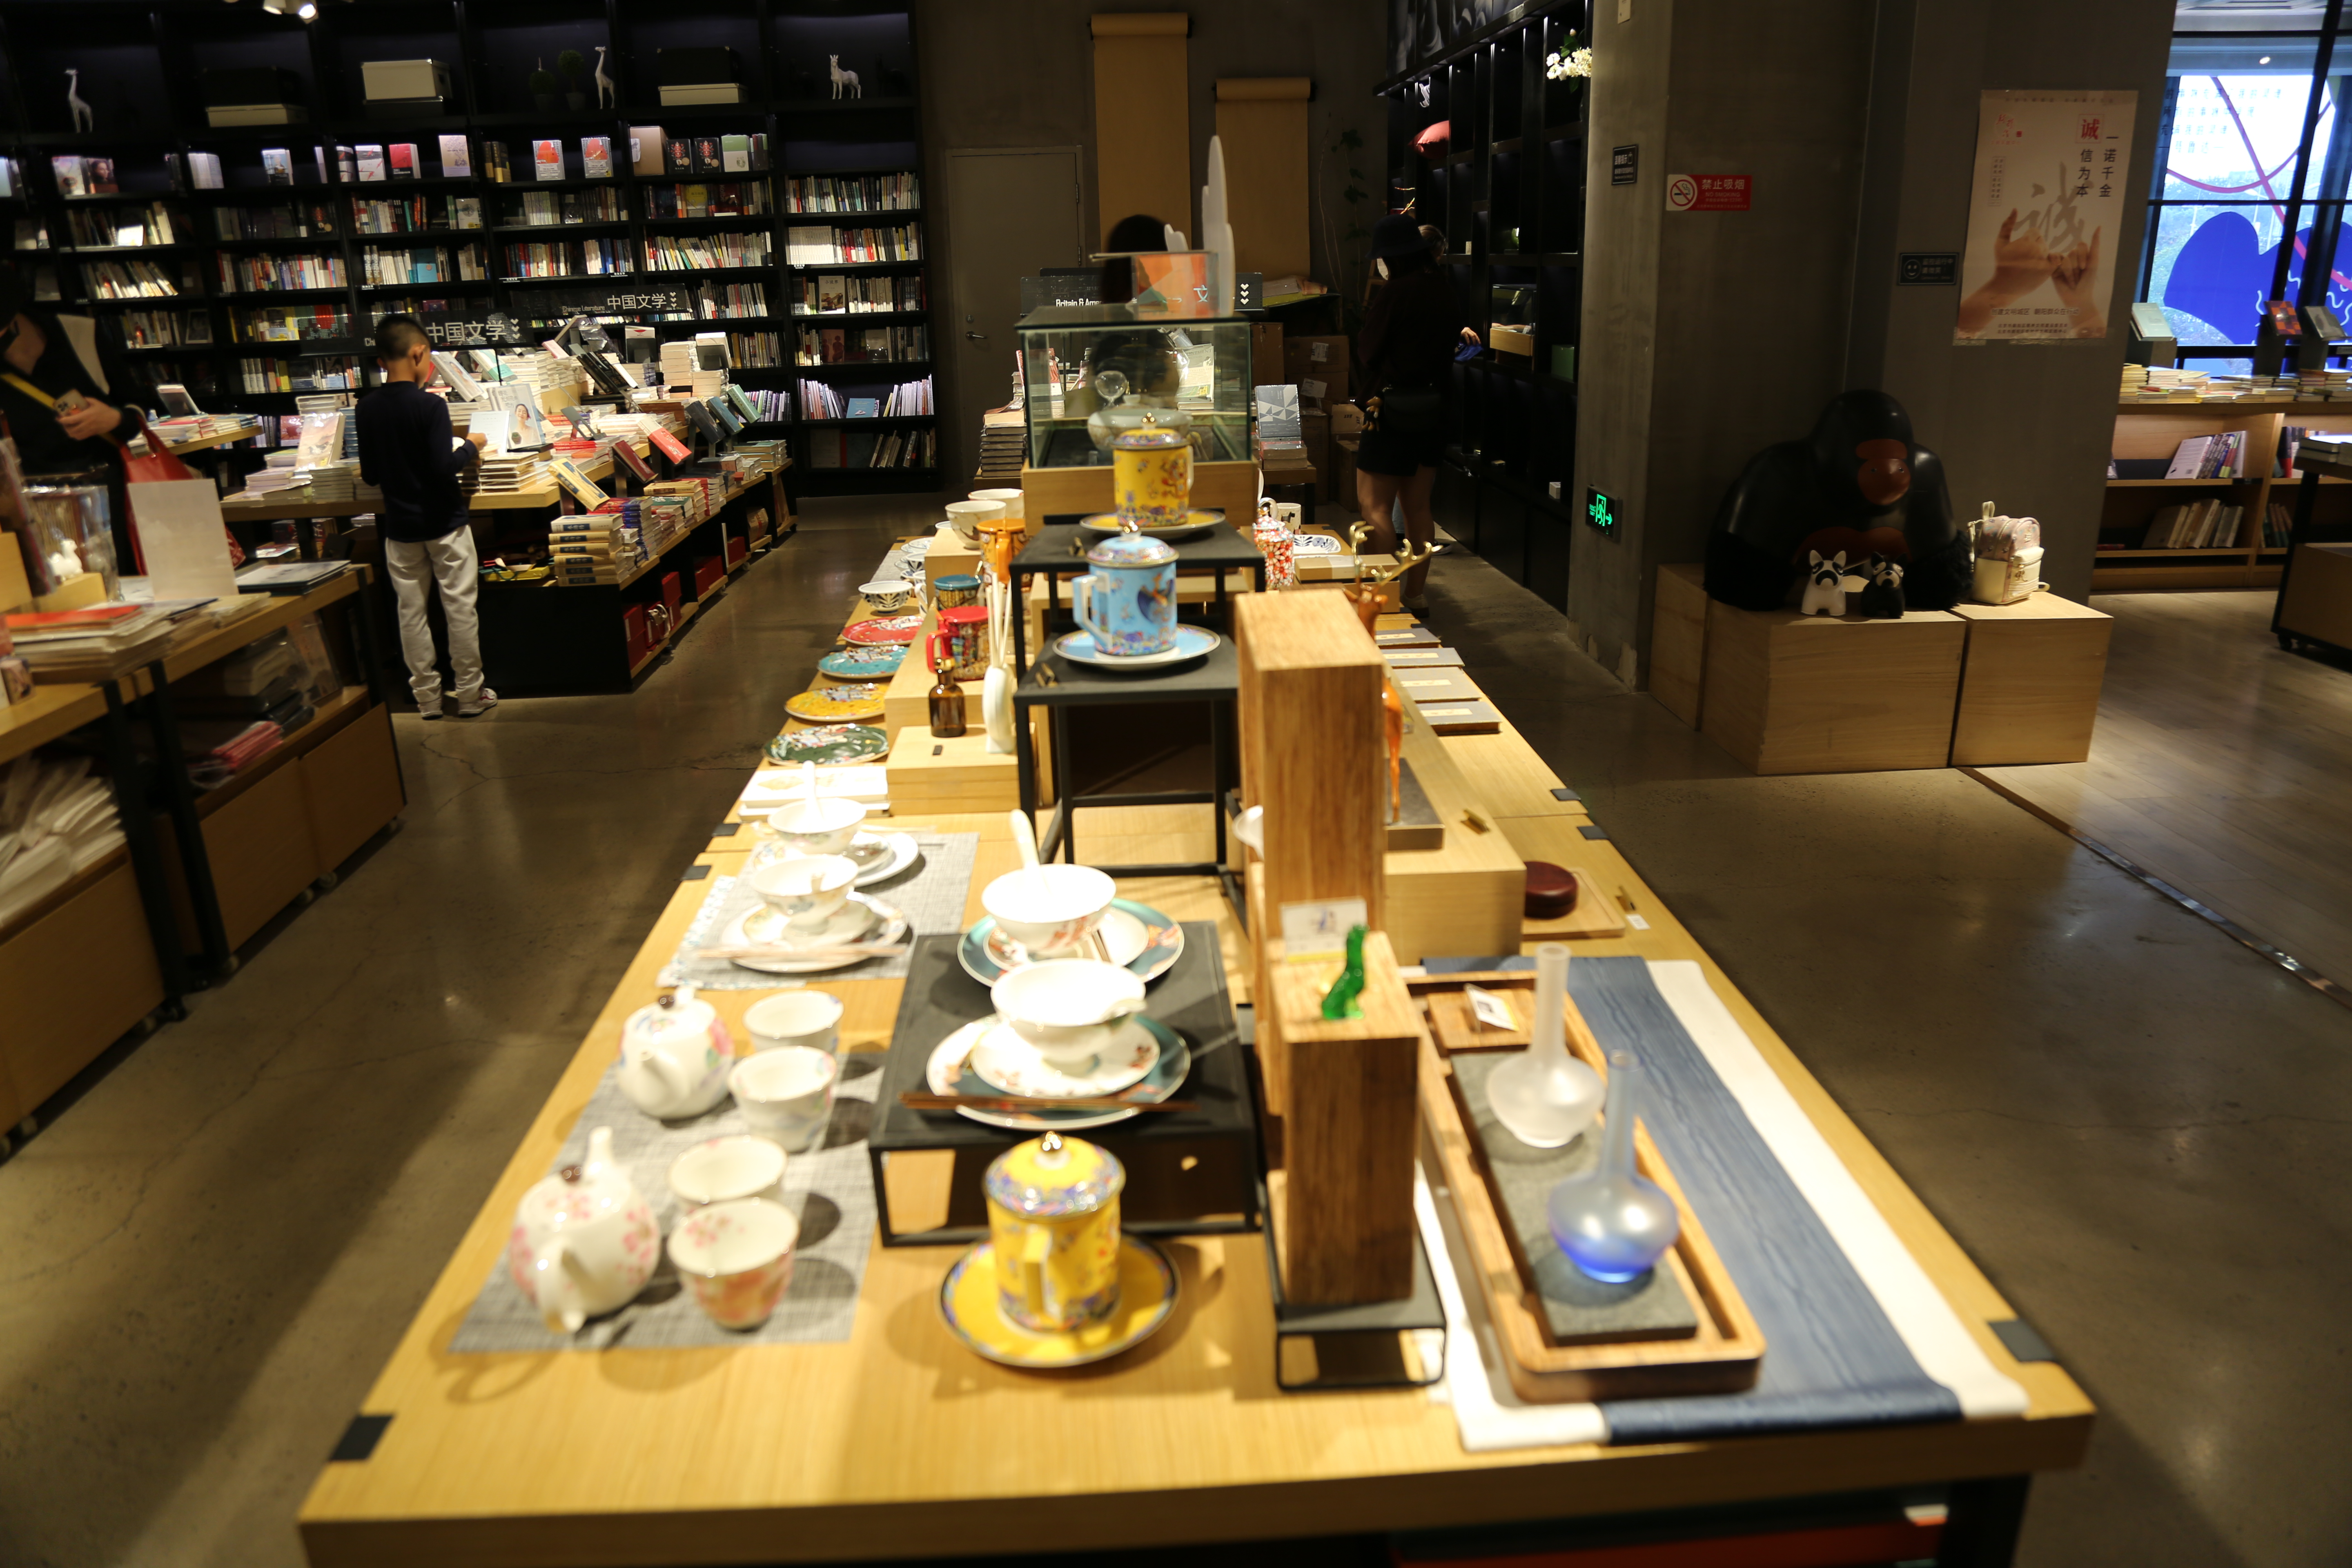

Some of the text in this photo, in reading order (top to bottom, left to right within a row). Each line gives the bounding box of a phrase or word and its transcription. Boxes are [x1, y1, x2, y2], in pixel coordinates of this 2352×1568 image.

[2099, 135, 2119, 198] 一诺千金
[1702, 178, 1745, 190] 禁止吸烟
[607, 293, 667, 310] 中国文学
[425, 320, 507, 343] 中国文学
